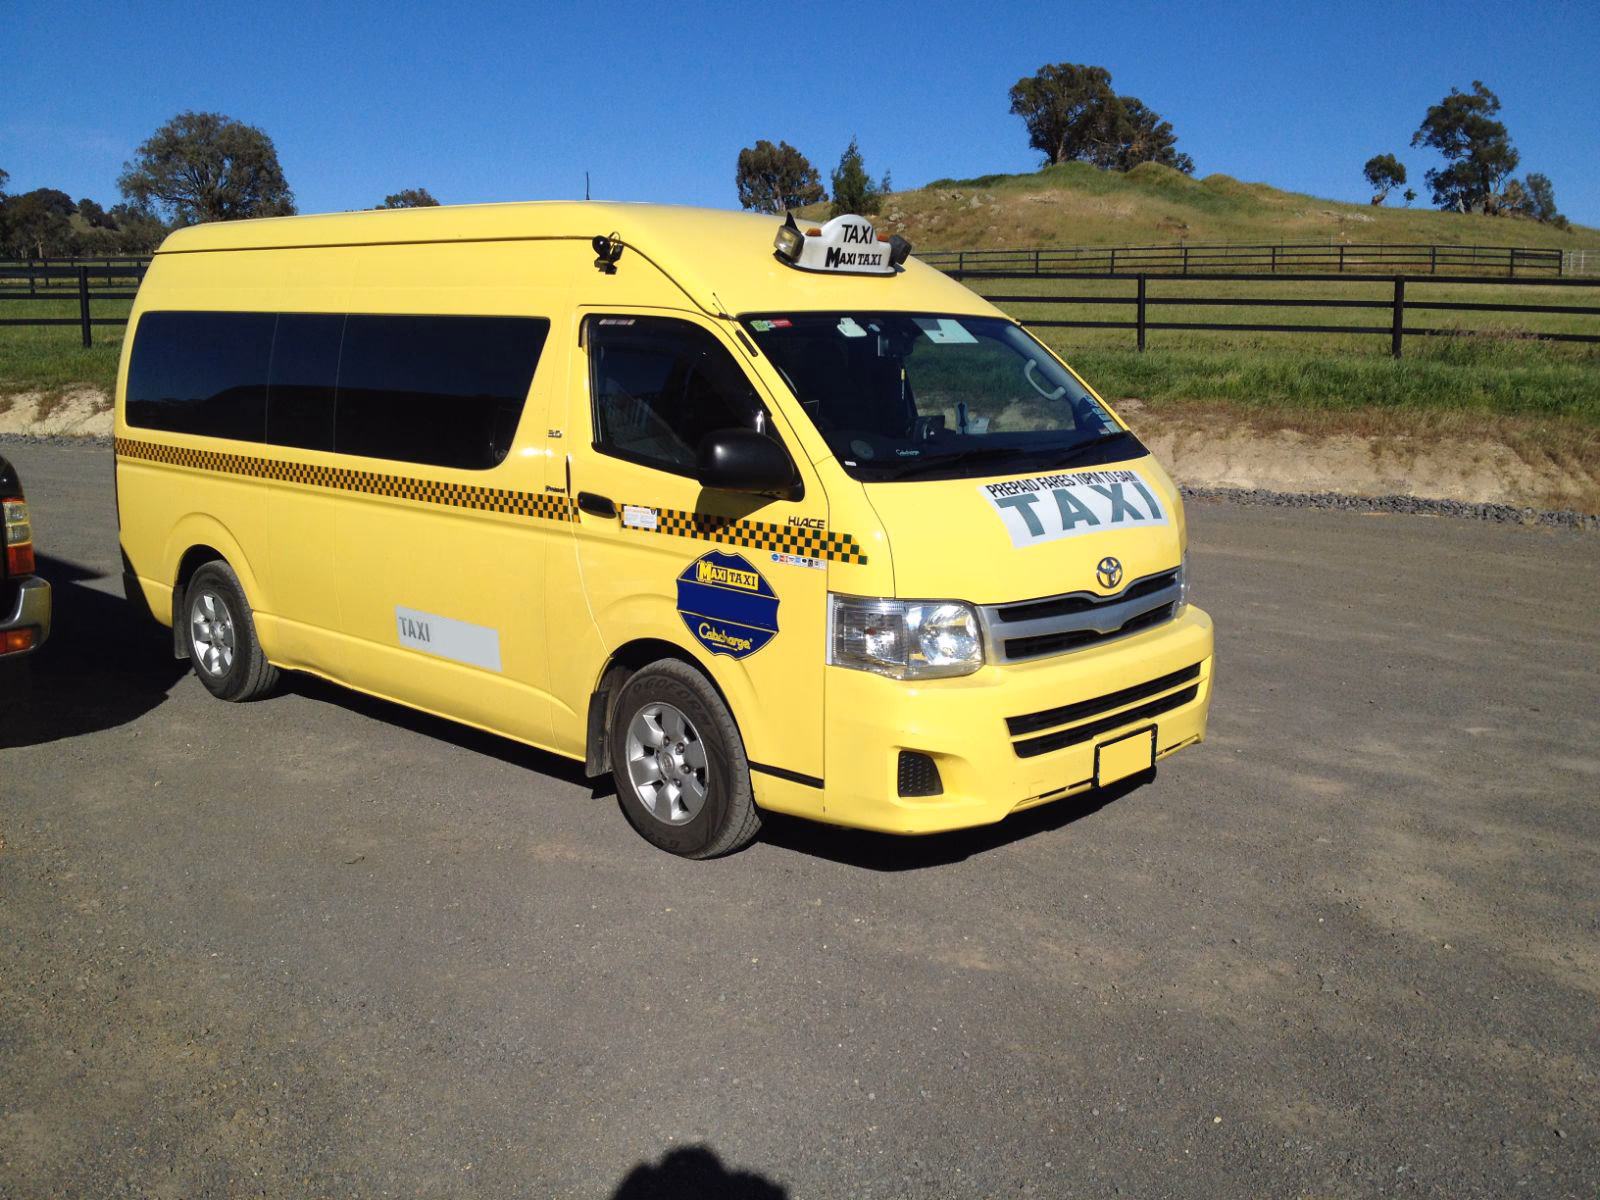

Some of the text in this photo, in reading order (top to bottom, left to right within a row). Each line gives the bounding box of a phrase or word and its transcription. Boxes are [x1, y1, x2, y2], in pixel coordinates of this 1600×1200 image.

[842, 224, 874, 244] TAXI
[857, 253, 882, 266] TAXI
[985, 470, 1139, 498] PREPAID FARES 10PM TO 5AM
[994, 482, 1162, 537] TAXI
[788, 515, 825, 530] HIACE
[728, 571, 756, 587] TAXI
[399, 616, 431, 642] TAXI
[699, 622, 752, 651] Cabcharge
